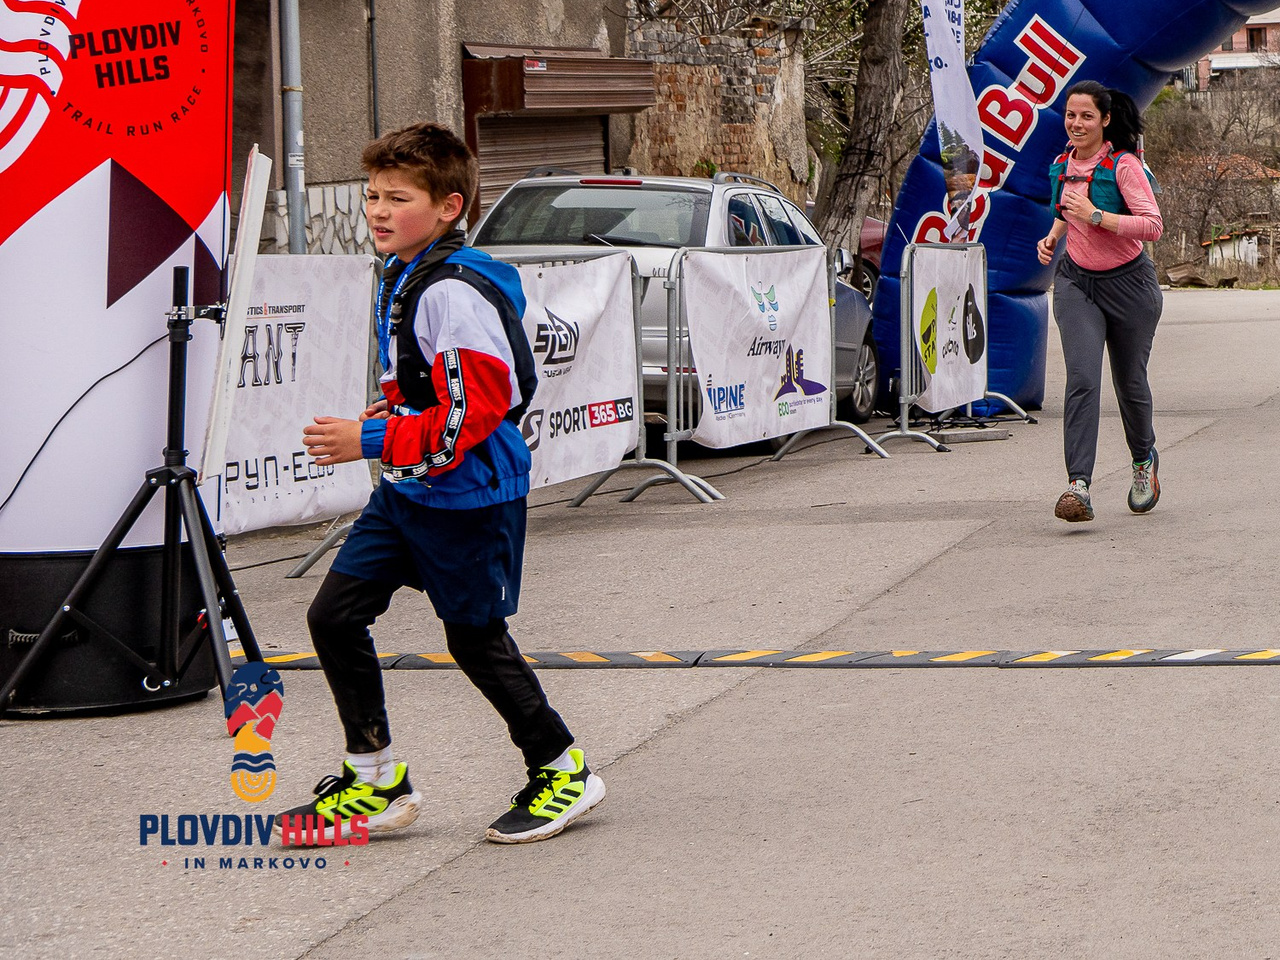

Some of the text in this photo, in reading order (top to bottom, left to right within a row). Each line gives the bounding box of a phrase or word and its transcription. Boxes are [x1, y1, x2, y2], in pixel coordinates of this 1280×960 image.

[68, 20, 181, 60] PLOVDIV
[94, 54, 171, 89] HILLS
[976, 17, 1082, 148] Bull
[62, 85, 202, 137] TRAIL RUN RACE
[268, 304, 306, 314] TRANSPORT
